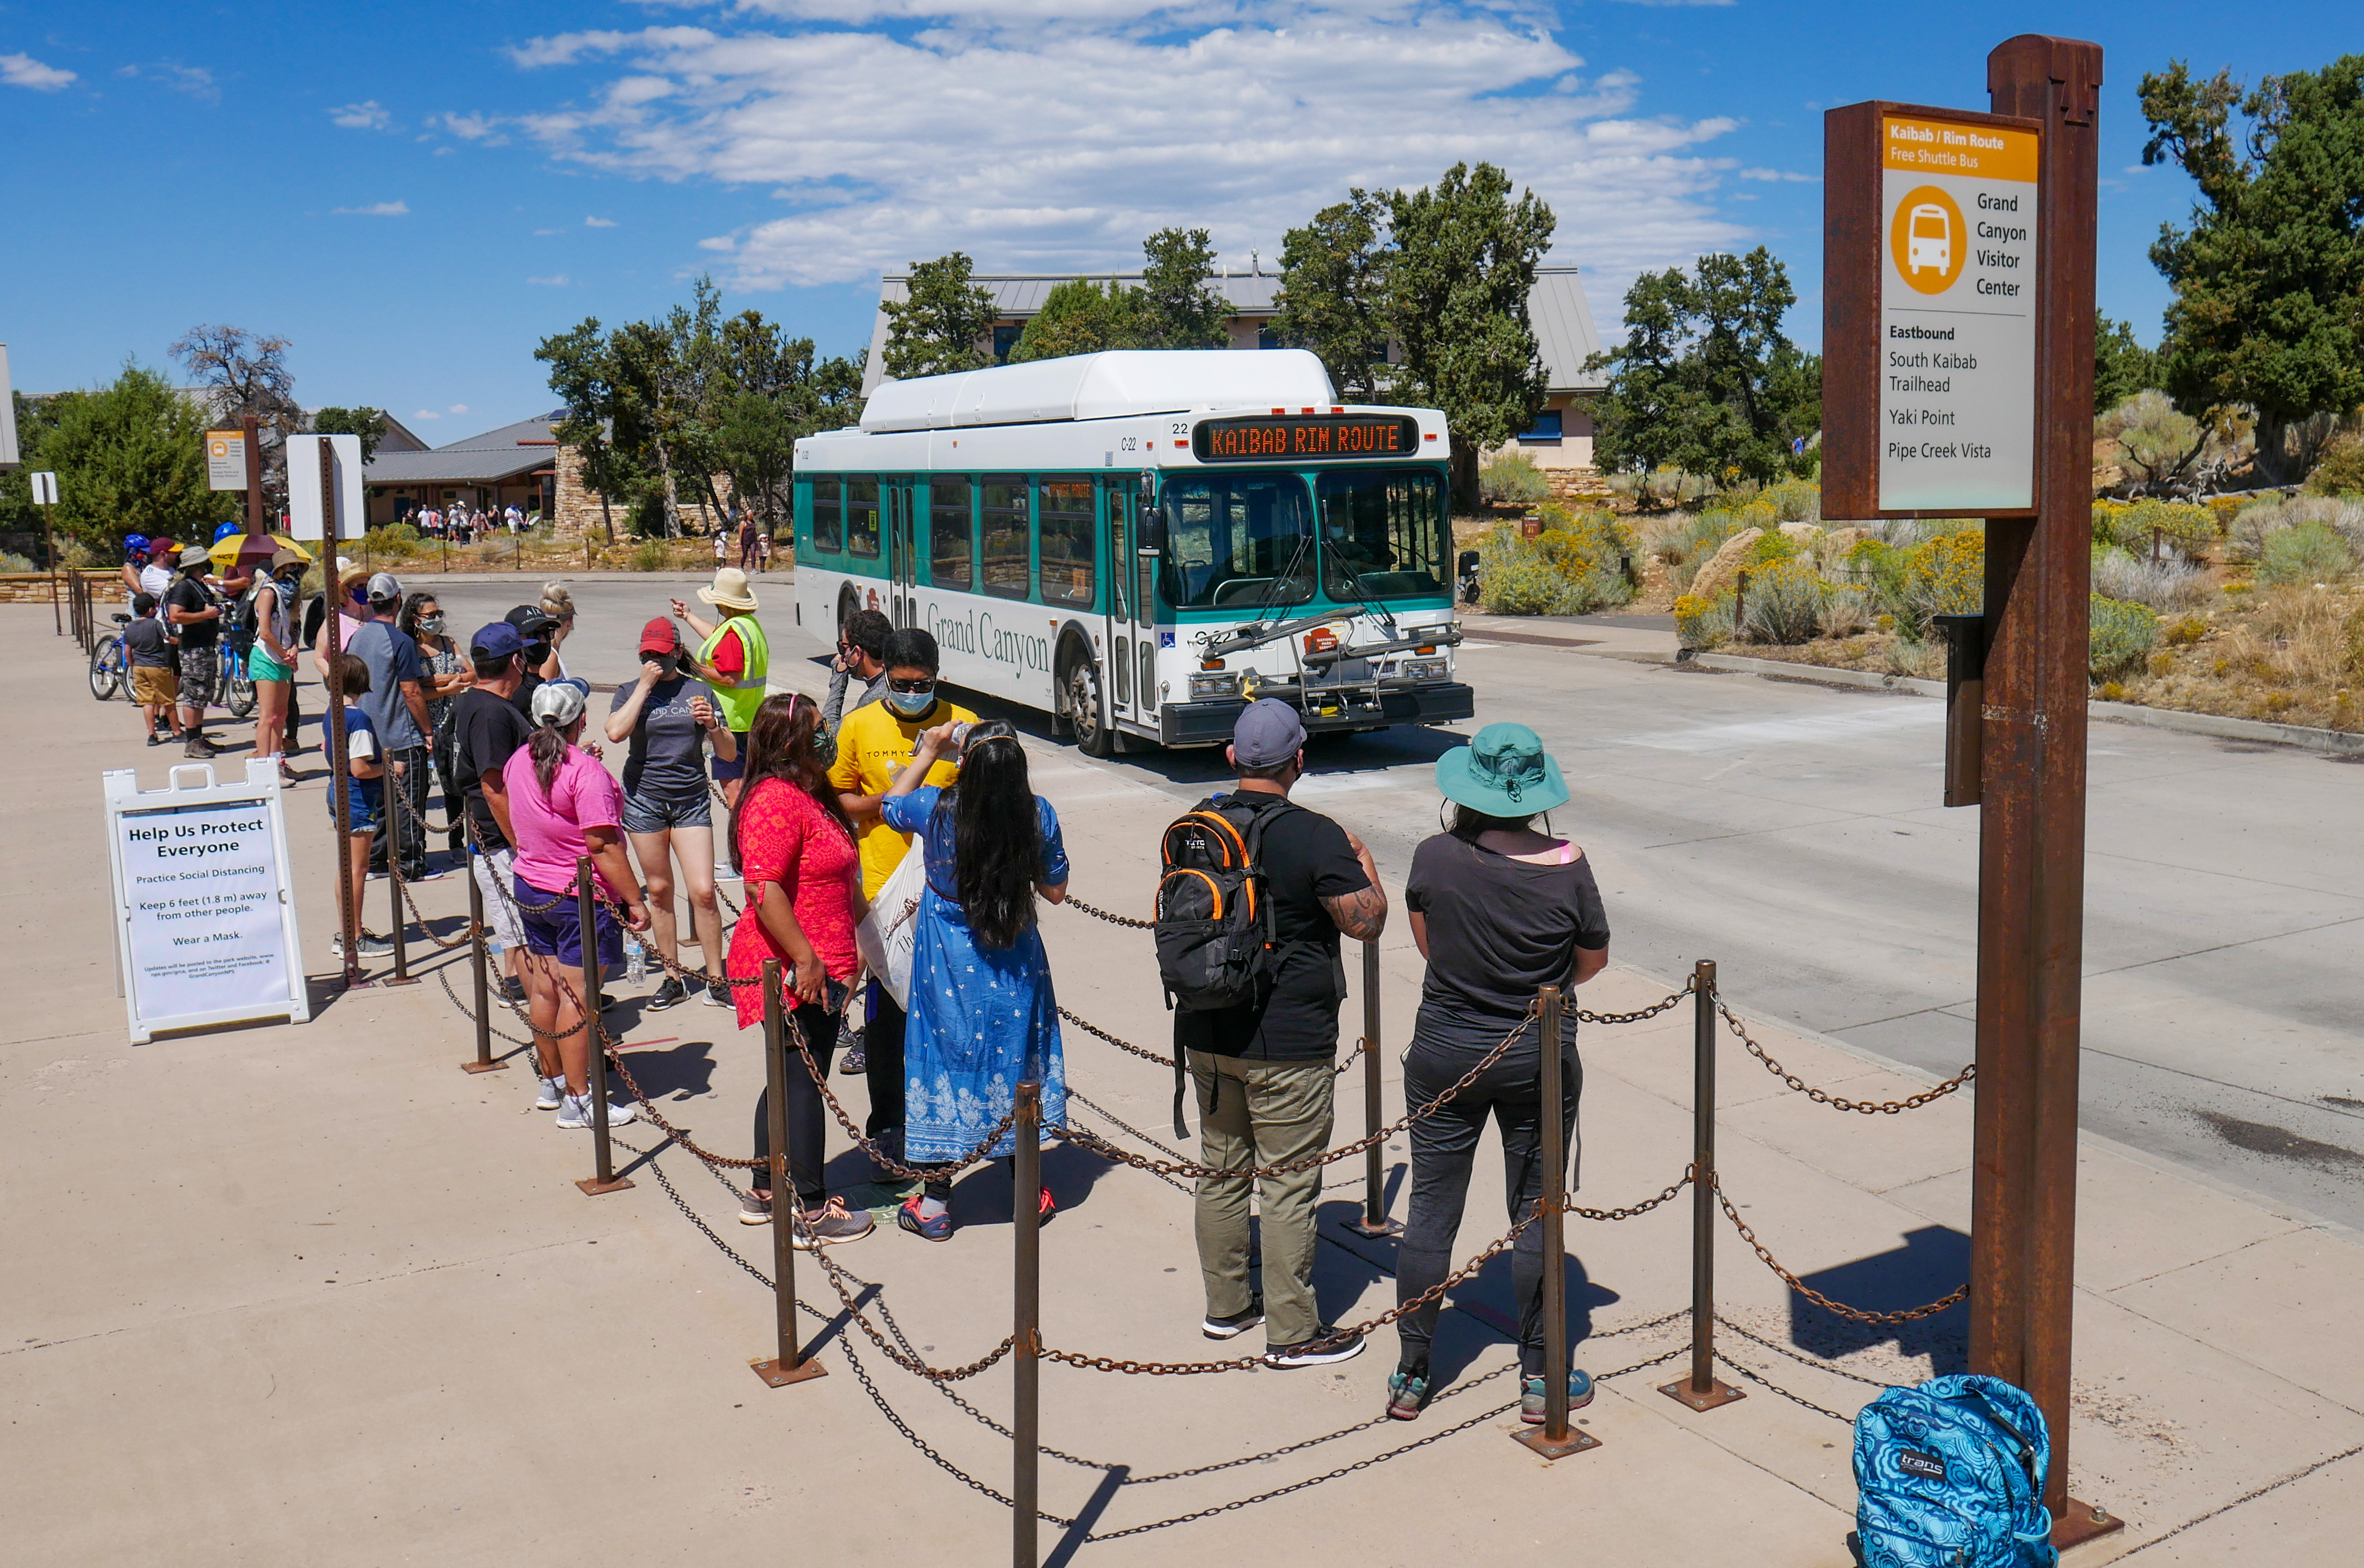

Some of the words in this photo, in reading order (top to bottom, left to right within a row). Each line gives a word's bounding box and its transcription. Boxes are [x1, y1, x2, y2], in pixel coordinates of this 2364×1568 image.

[1891, 125, 1934, 143] Kaibab
[1936, 130, 1941, 143] /
[1943, 131, 1967, 146] Rim
[1970, 134, 2005, 150] Route
[1891, 147, 1915, 162] Free
[1918, 149, 1957, 166] Shuttle
[1960, 154, 1978, 168] Bus
[1978, 193, 2018, 211] Grand
[1977, 221, 2026, 243] Canyon
[1977, 249, 2020, 268] Visitor
[1977, 278, 2020, 296] Center
[1890, 325, 1955, 341] Eastbound
[1890, 351, 1928, 368] South
[1933, 353, 1977, 369] Kaibab
[1890, 375, 1950, 392] Trailhead
[1890, 408, 1917, 425] Yaki
[1922, 409, 1955, 425] Point
[1172, 423, 1188, 435] 22
[1121, 437, 1136, 451] C-22
[1212, 428, 1287, 454] KAIBAB
[1295, 427, 1329, 452] RIM
[1339, 425, 1398, 451] ROUTE
[1889, 442, 1917, 462] Pipe
[1922, 442, 1957, 458] Creek
[1962, 442, 1991, 458] Vista
[1072, 484, 1090, 497] ROUTE
[928, 603, 976, 655] Grand
[980, 612, 1050, 679] Canyon
[1195, 631, 1231, 645] C22
[866, 750, 905, 759] TOMMY
[129, 827, 168, 842] Help
[175, 825, 195, 837] Us
[201, 819, 263, 835] Protect
[157, 841, 239, 857] Everyone
[136, 874, 176, 884] Practice
[179, 870, 209, 880] Social
[212, 865, 264, 877] Distancing
[140, 902, 166, 911] Keep
[169, 899, 175, 908] 6
[178, 898, 199, 907] feet
[202, 895, 220, 906] (1.8
[224, 893, 237, 903] m)
[240, 892, 267, 900] away
[156, 912, 181, 920] from
[185, 909, 213, 917] other
[216, 904, 253, 916] people.
[173, 936, 200, 946] Wear
[213, 931, 243, 941] Mask.
[188, 969, 235, 979] GrandCanyonNPS
[1902, 1454, 1943, 1475] trans
